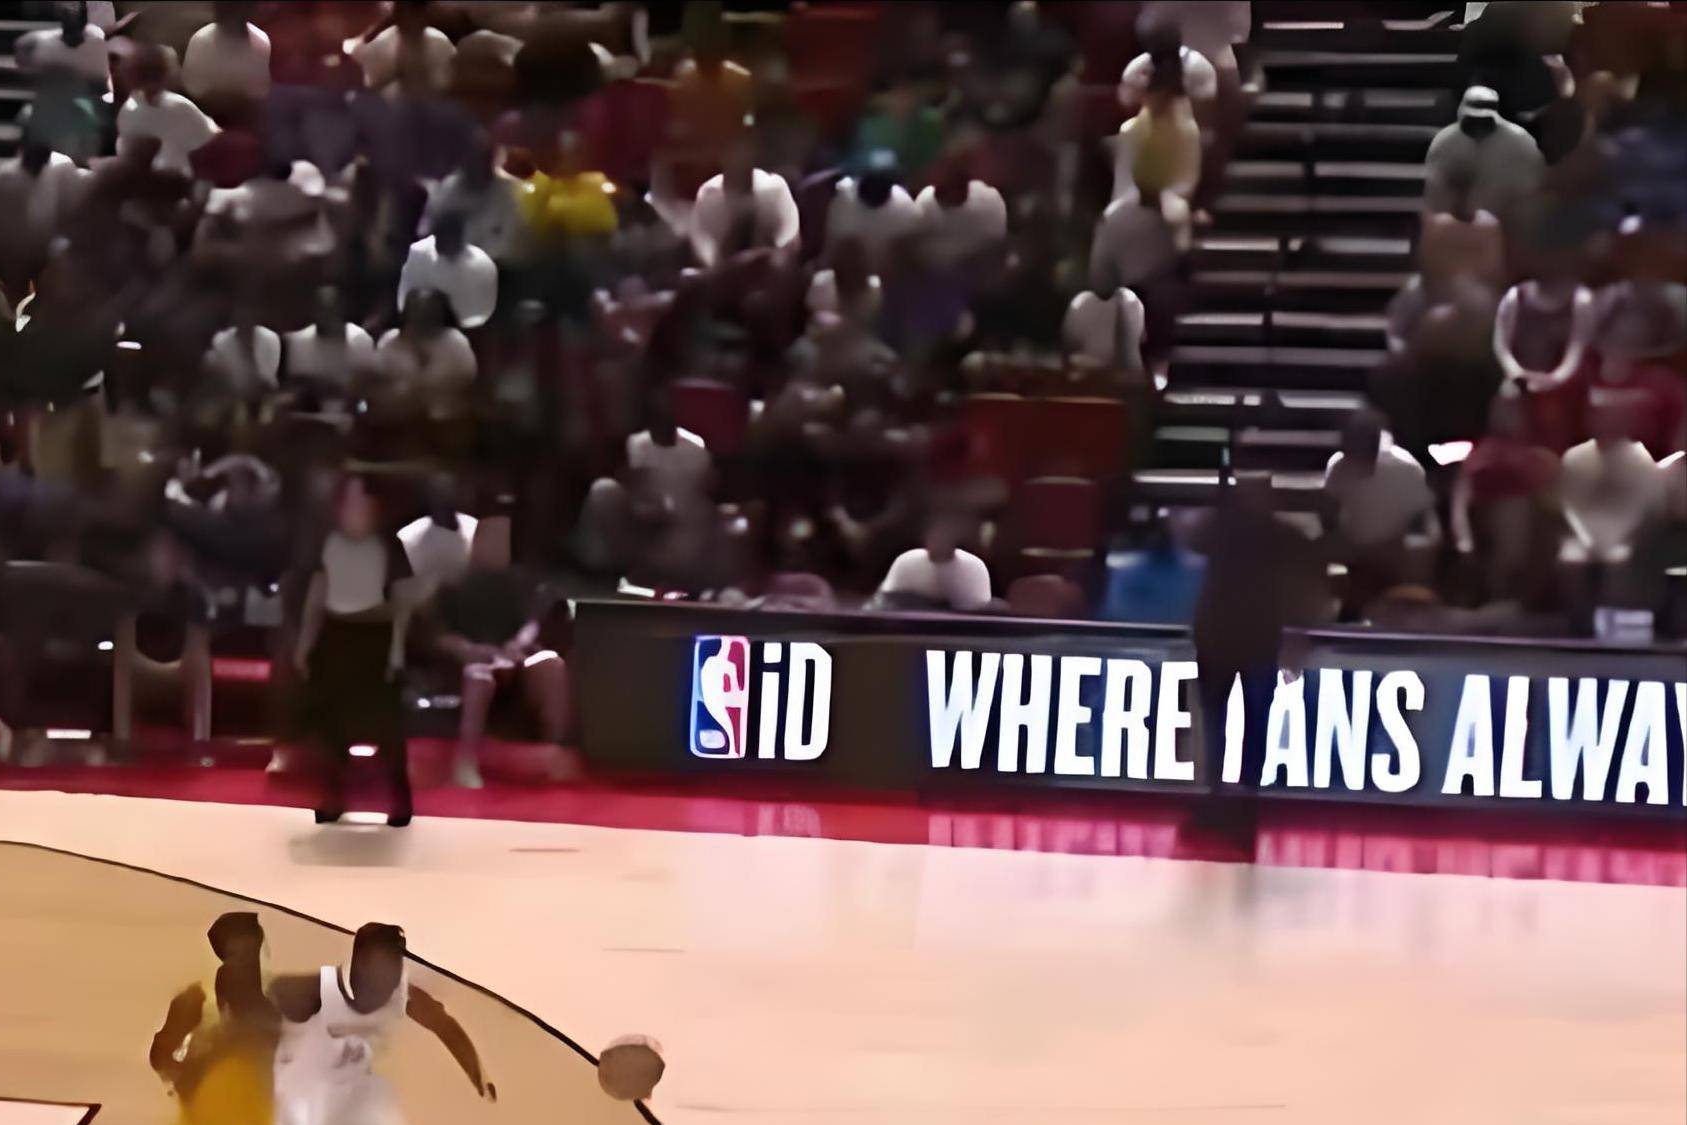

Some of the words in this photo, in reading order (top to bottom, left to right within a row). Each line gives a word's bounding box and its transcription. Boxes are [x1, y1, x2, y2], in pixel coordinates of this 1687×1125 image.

[758, 641, 833, 761] iD
[926, 649, 1199, 781] WHERE
[1441, 674, 1687, 807] ALWA
